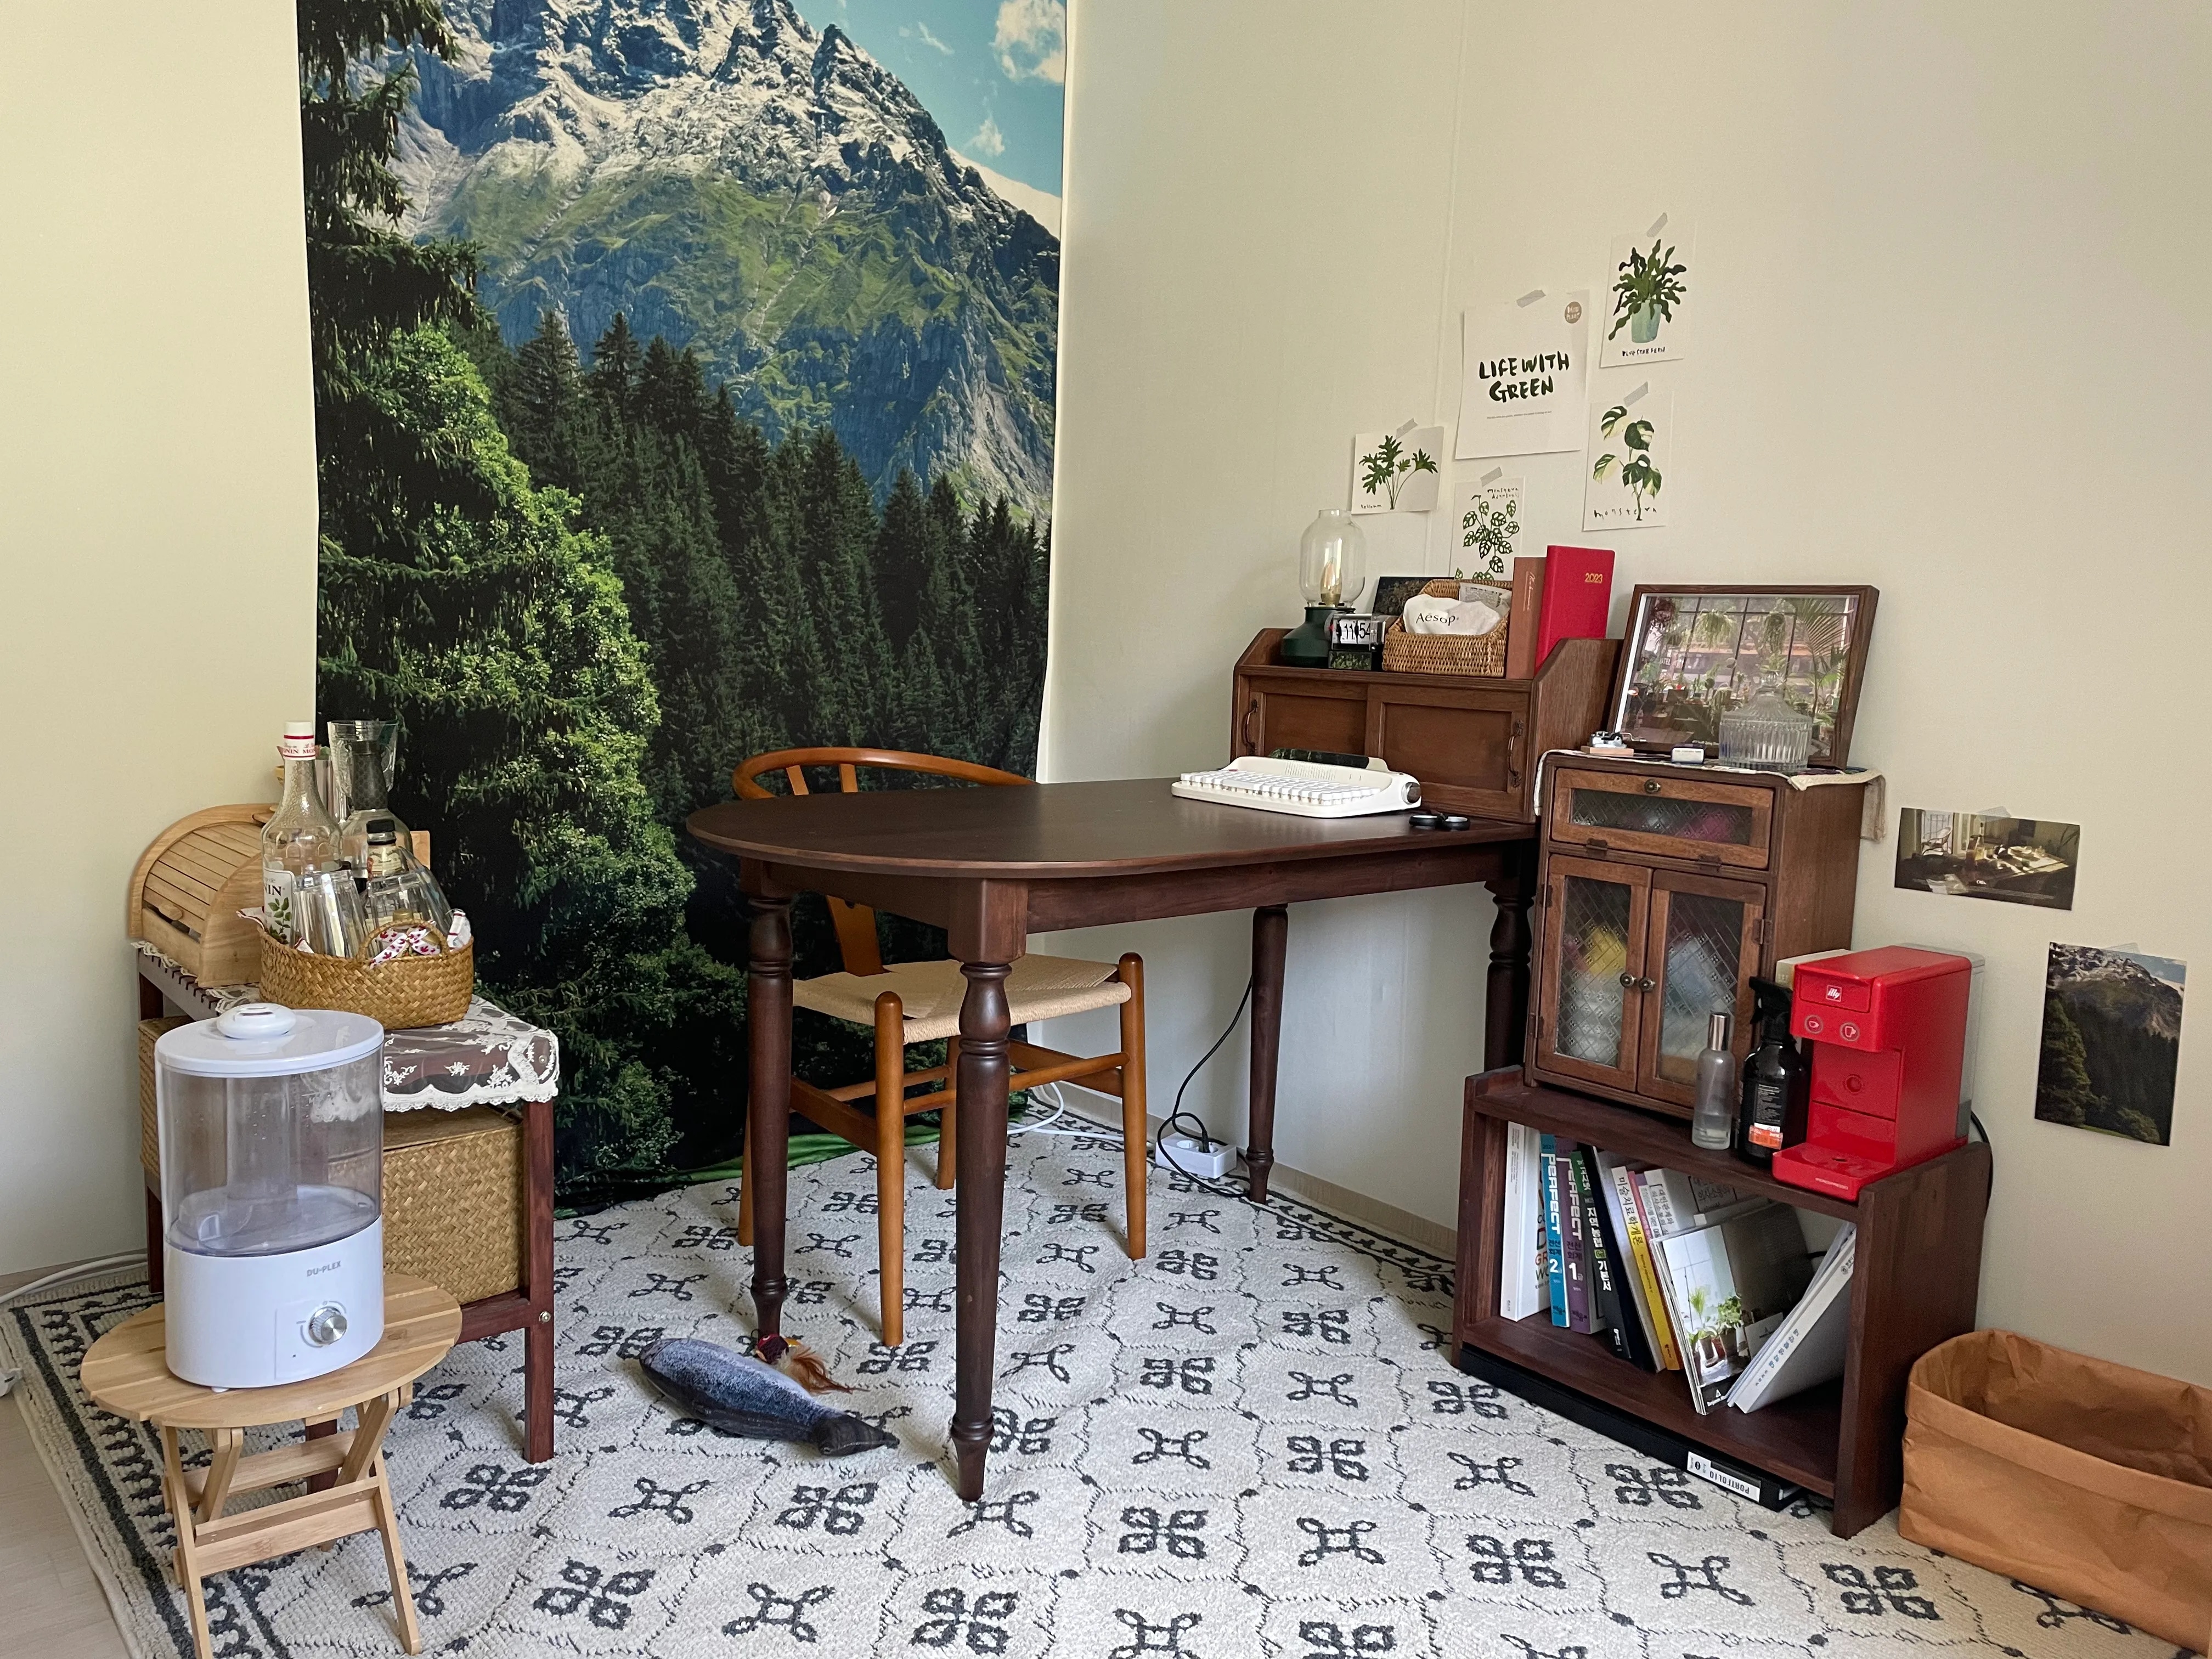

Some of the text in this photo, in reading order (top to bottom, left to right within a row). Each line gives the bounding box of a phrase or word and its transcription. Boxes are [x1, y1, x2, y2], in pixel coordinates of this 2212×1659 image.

[1479, 351, 1570, 379] LIFE WITH
[1489, 375, 1554, 403] GREEN
[1584, 573, 1603, 584] 2023
[1415, 613, 1456, 626] Aesop
[1827, 988, 1841, 999] illy
[1618, 1177, 1644, 1245] 미술치료학개론
[307, 1261, 341, 1277] DU-PLEX
[1709, 1471, 1750, 1494] PORTFOLIO
